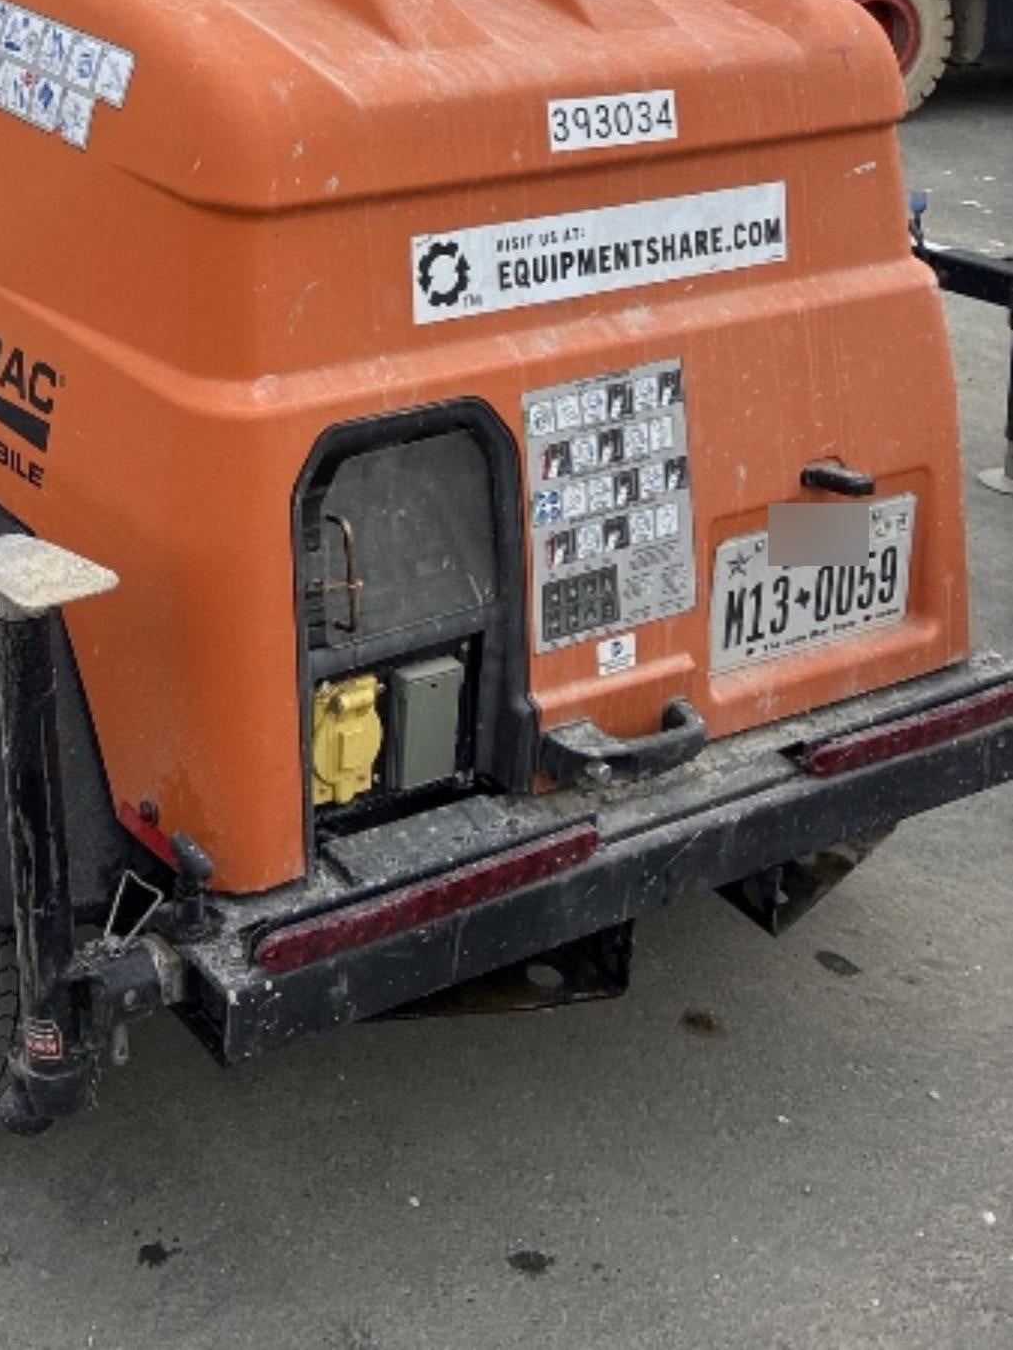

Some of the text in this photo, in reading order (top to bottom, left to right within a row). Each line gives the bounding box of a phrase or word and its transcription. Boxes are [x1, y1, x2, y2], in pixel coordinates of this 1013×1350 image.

[552, 98, 672, 142] 393034
[496, 227, 586, 252] VISIT US AT:
[497, 217, 782, 292] EQUIPMENTSHARE.COM
